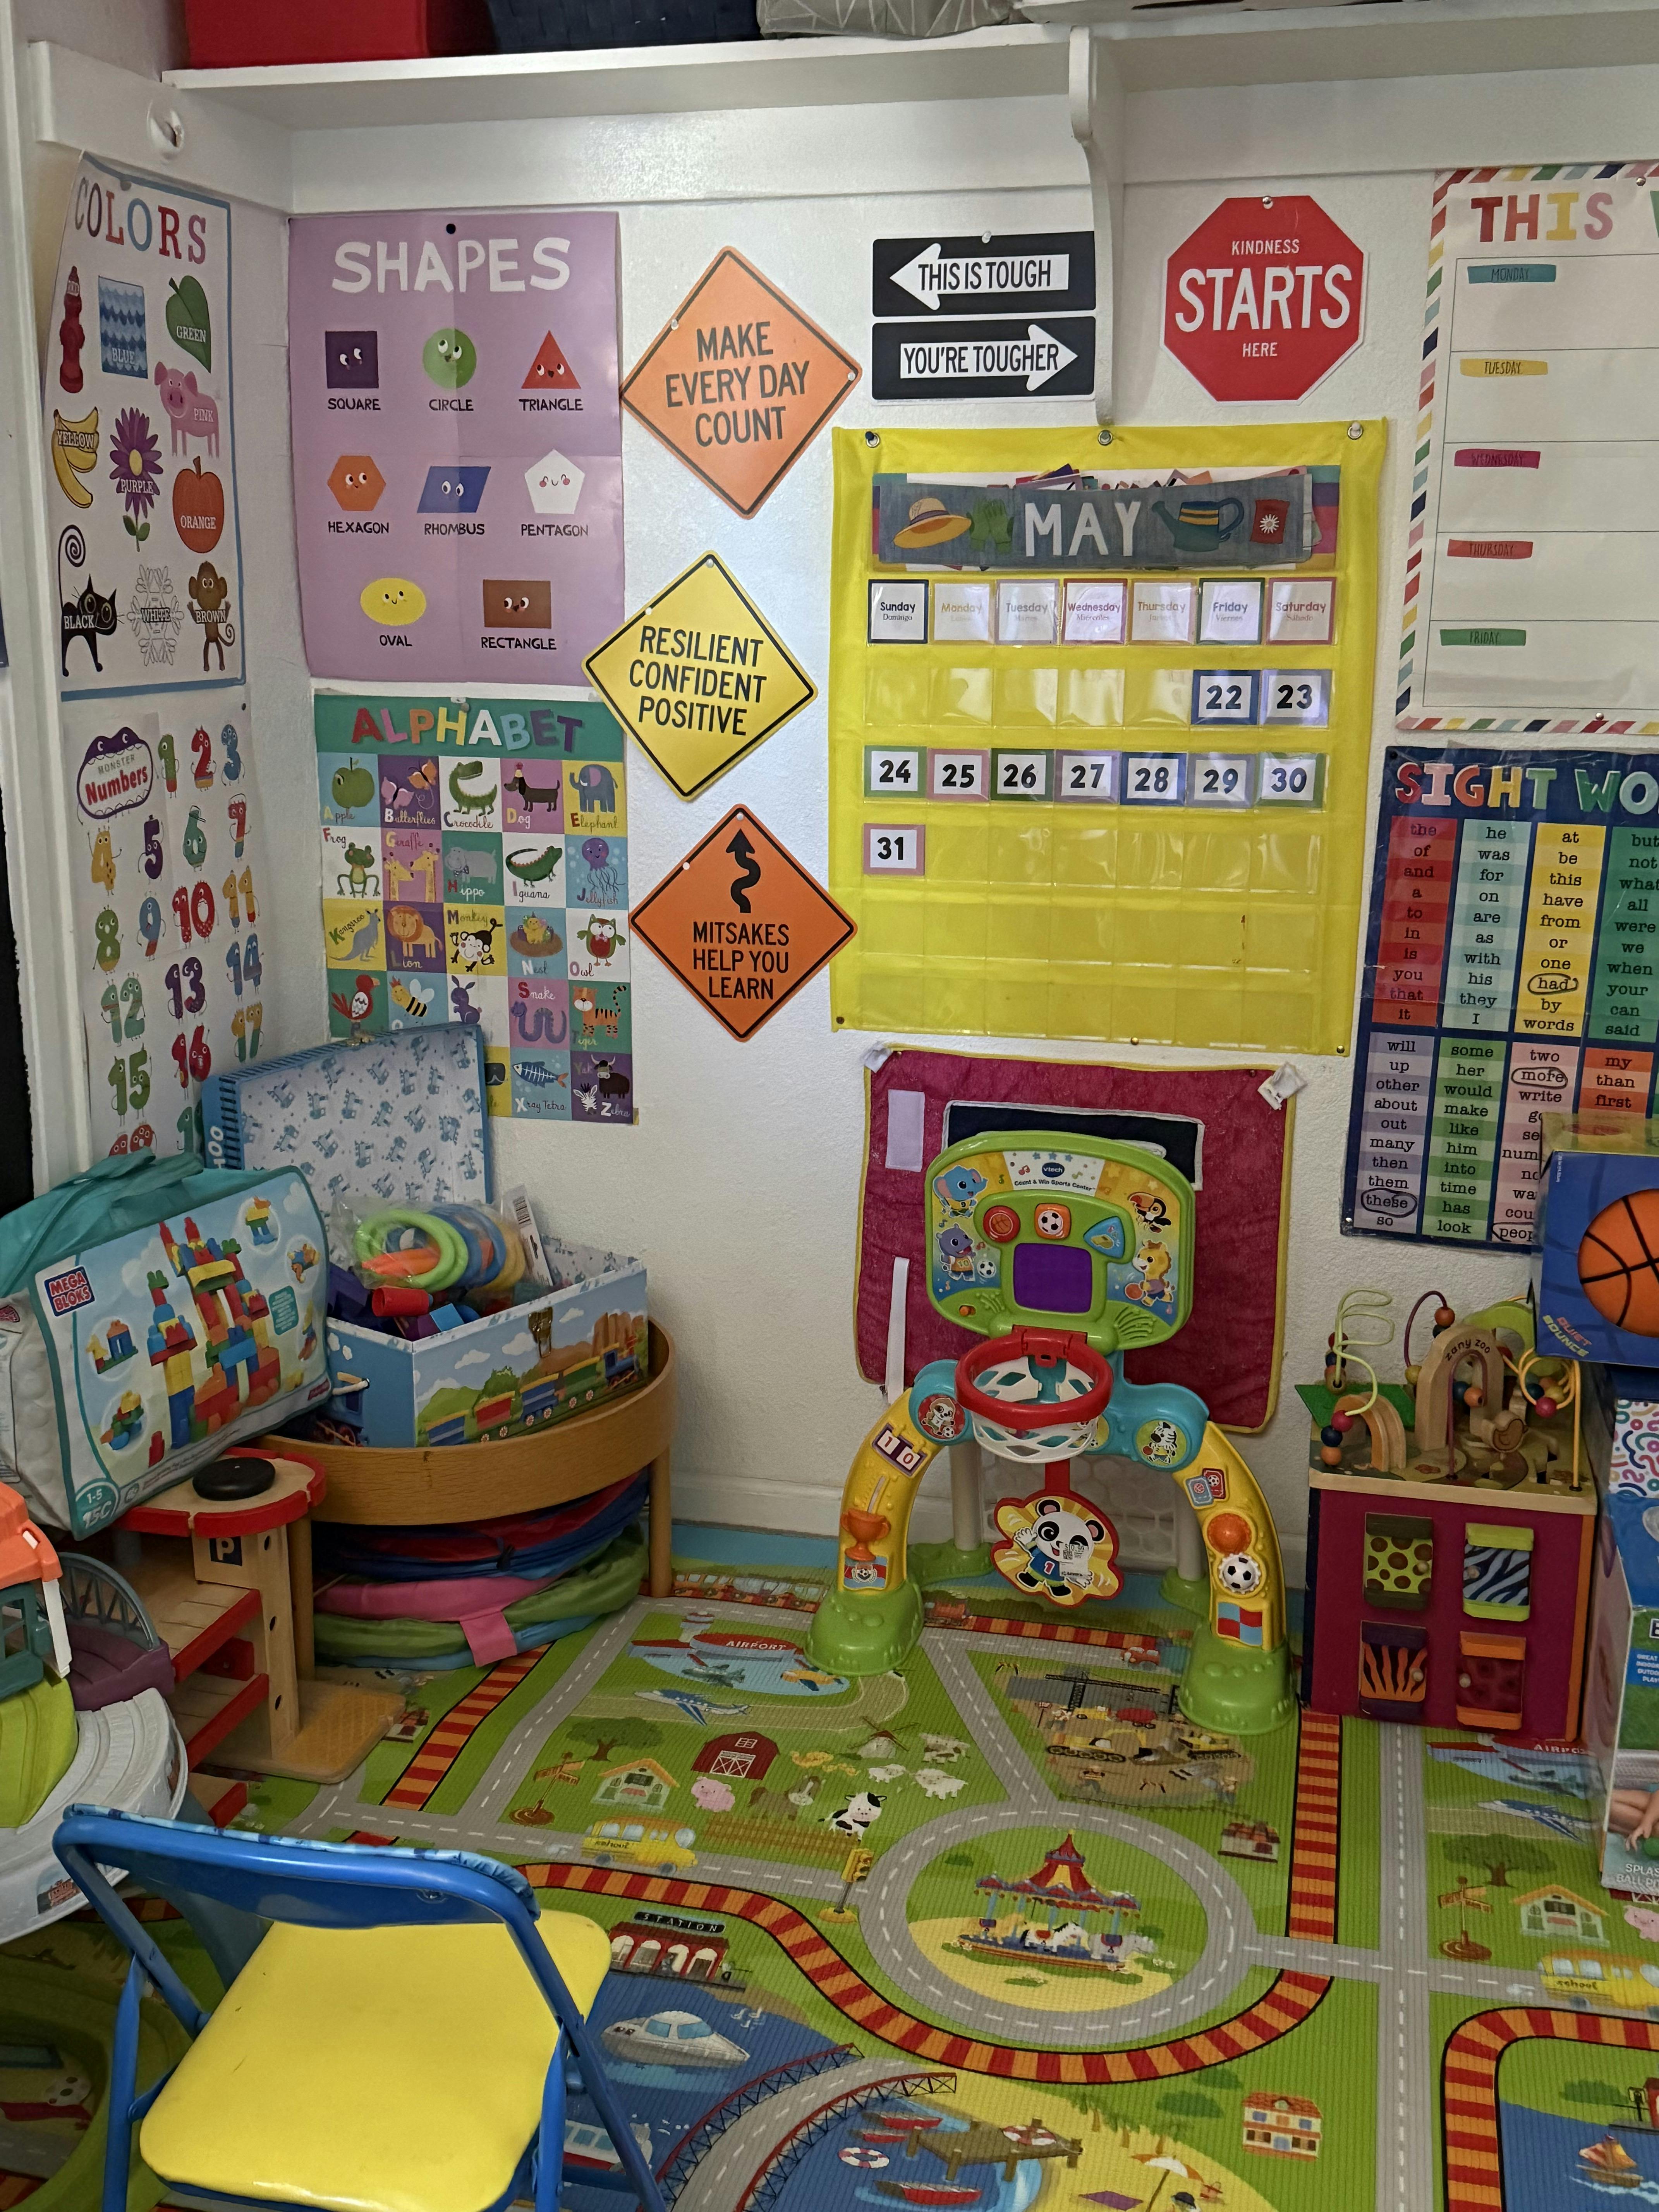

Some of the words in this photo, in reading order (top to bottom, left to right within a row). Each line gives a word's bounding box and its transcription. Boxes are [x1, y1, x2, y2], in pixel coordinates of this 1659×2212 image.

[75, 177, 206, 264] COLORS
[1471, 192, 1613, 242] THIS
[1231, 239, 1300, 256] KINDNESS
[331, 237, 570, 293] SHAPES
[918, 262, 960, 291] THIS
[965, 261, 982, 290] IS
[985, 259, 1051, 289] TOUGH
[1491, 268, 1530, 282] MONDAY
[1175, 264, 1352, 333] STARTS
[176, 325, 206, 343] GREEN
[696, 321, 773, 362] MAKE
[112, 348, 136, 365] BLUE
[904, 346, 968, 374] YOU'RE
[973, 343, 1059, 373] TOUGHER
[1242, 342, 1278, 357] HERE
[1485, 361, 1522, 375] TUESDAY
[665, 365, 751, 408] EVERY
[759, 360, 810, 398] DAY
[327, 398, 381, 411] SQUARE
[429, 399, 474, 412] CIRCLE
[519, 398, 584, 412] TRIANGLE
[194, 408, 213, 422] PINK
[696, 405, 786, 447] COUNT
[57, 431, 94, 448] YELLOW
[121, 479, 153, 494] PURPLE
[180, 515, 216, 529] ORANGE
[328, 521, 389, 534] HEXAGON
[424, 523, 485, 536] RHOMBUS
[521, 524, 589, 537] PENTAGON
[1025, 501, 1141, 557] MAY
[1470, 543, 1514, 557] THURSDAY
[141, 608, 170, 622] WHITE
[196, 610, 226, 623] BROWN
[880, 601, 915, 614] Sunday
[941, 603, 983, 614] Monday
[1006, 603, 1048, 614] Tuesday
[1068, 602, 1121, 614] Wednesday
[1137, 601, 1186, 614] Thursday
[1212, 601, 1248, 615] Friday
[1275, 601, 1326, 614] Saturday
[64, 615, 94, 629] BLACK
[883, 613, 912, 622] Domingo
[379, 635, 413, 647] OVAL
[481, 637, 557, 650] RECTANGLE
[639, 625, 764, 667] RESILIENT
[1470, 631, 1499, 645] FRIDAY
[629, 659, 767, 703] CONFIDENT
[1206, 685, 1242, 710] 22
[1276, 684, 1313, 709] 23
[638, 695, 747, 736] POSITIVE
[351, 707, 582, 753] ALPHABET
[191, 728, 214, 789] 2
[221, 724, 240, 781] 3
[98, 754, 135, 775] MONSTER
[158, 734, 177, 792] 1
[879, 759, 911, 783] 24
[942, 764, 974, 788] 25
[1003, 763, 1036, 788] 26
[1070, 763, 1105, 788] 27
[1135, 767, 1170, 792] 28
[1203, 768, 1238, 794] 29
[1270, 767, 1307, 793] 30
[85, 765, 148, 805] Numbers
[1395, 762, 1557, 810] SIGHT
[1575, 768, 1659, 814] WO
[323, 806, 355, 824] Apple
[384, 808, 436, 825] Butterflies
[444, 811, 494, 829] Crocodile
[507, 807, 531, 829] Dog
[571, 812, 619, 835] Elephant
[182, 809, 207, 867] 6
[228, 801, 246, 859] 7
[323, 827, 346, 848] Frog
[144, 818, 163, 879] 5
[386, 831, 424, 850] Giraffe
[877, 836, 904, 860] 31
[91, 830, 116, 891] 4
[1549, 873, 1582, 886] this
[223, 866, 256, 928] 11
[448, 879, 485, 902] Hippo
[512, 881, 550, 903] Iguana
[576, 888, 618, 908] Jellyfish
[1542, 893, 1583, 907] have
[172, 881, 215, 943] 10
[447, 909, 488, 927] Monkey
[139, 896, 161, 957] 9
[329, 914, 364, 945] Kangaroo
[1540, 915, 1581, 929] from
[95, 909, 120, 972] 8
[693, 921, 789, 946] MITSAKES
[226, 933, 262, 996] 14
[389, 950, 423, 968] Lion
[521, 959, 548, 975] Nest
[693, 948, 744, 972] HELP
[749, 951, 789, 973] YOU
[1464, 953, 1501, 966] with
[569, 961, 595, 977] Owl
[1393, 969, 1423, 982] you
[165, 957, 205, 1019] 13
[518, 981, 555, 1000] Snake
[709, 976, 773, 1000] LEARN
[1390, 988, 1424, 1001] that
[1606, 984, 1649, 997] your
[1460, 993, 1498, 1008] they
[101, 977, 144, 1044] 12
[231, 1003, 263, 1062] 17
[1523, 1018, 1575, 1032] words
[1605, 1024, 1640, 1037] said
[1387, 1041, 1416, 1053] will
[1451, 1046, 1494, 1058] some
[172, 1024, 211, 1089] 16
[108, 1049, 151, 1116] 15
[1376, 1080, 1420, 1091] other
[1521, 1070, 1565, 1083] more
[1597, 1074, 1635, 1088] than
[1444, 1085, 1492, 1097] would
[1518, 1089, 1562, 1103] write
[601, 1101, 630, 1117] Zebra
[1374, 1098, 1418, 1112] about
[1594, 1095, 1632, 1109] first
[1369, 1138, 1415, 1152] many
[1441, 1182, 1476, 1195] time
[1366, 1194, 1408, 1209] these
[1437, 1220, 1472, 1234] look
[49, 1271, 87, 1297] MEGA
[53, 1285, 91, 1312] BLOKS
[1543, 1315, 1589, 1357] BOUNCE
[1557, 1317, 1592, 1346] QUIET
[1445, 1339, 1471, 1361] zany
[1475, 1339, 1490, 1353] zoo
[884, 1436, 893, 1448] 1
[903, 1453, 914, 1464] 0
[87, 1488, 102, 1504] 1-5
[216, 1538, 234, 1561] P
[1044, 1561, 1055, 1575] 1
[726, 1640, 787, 1651] AIRPORT
[642, 1913, 719, 1932] STATION
[1556, 1979, 1598, 1990] school
